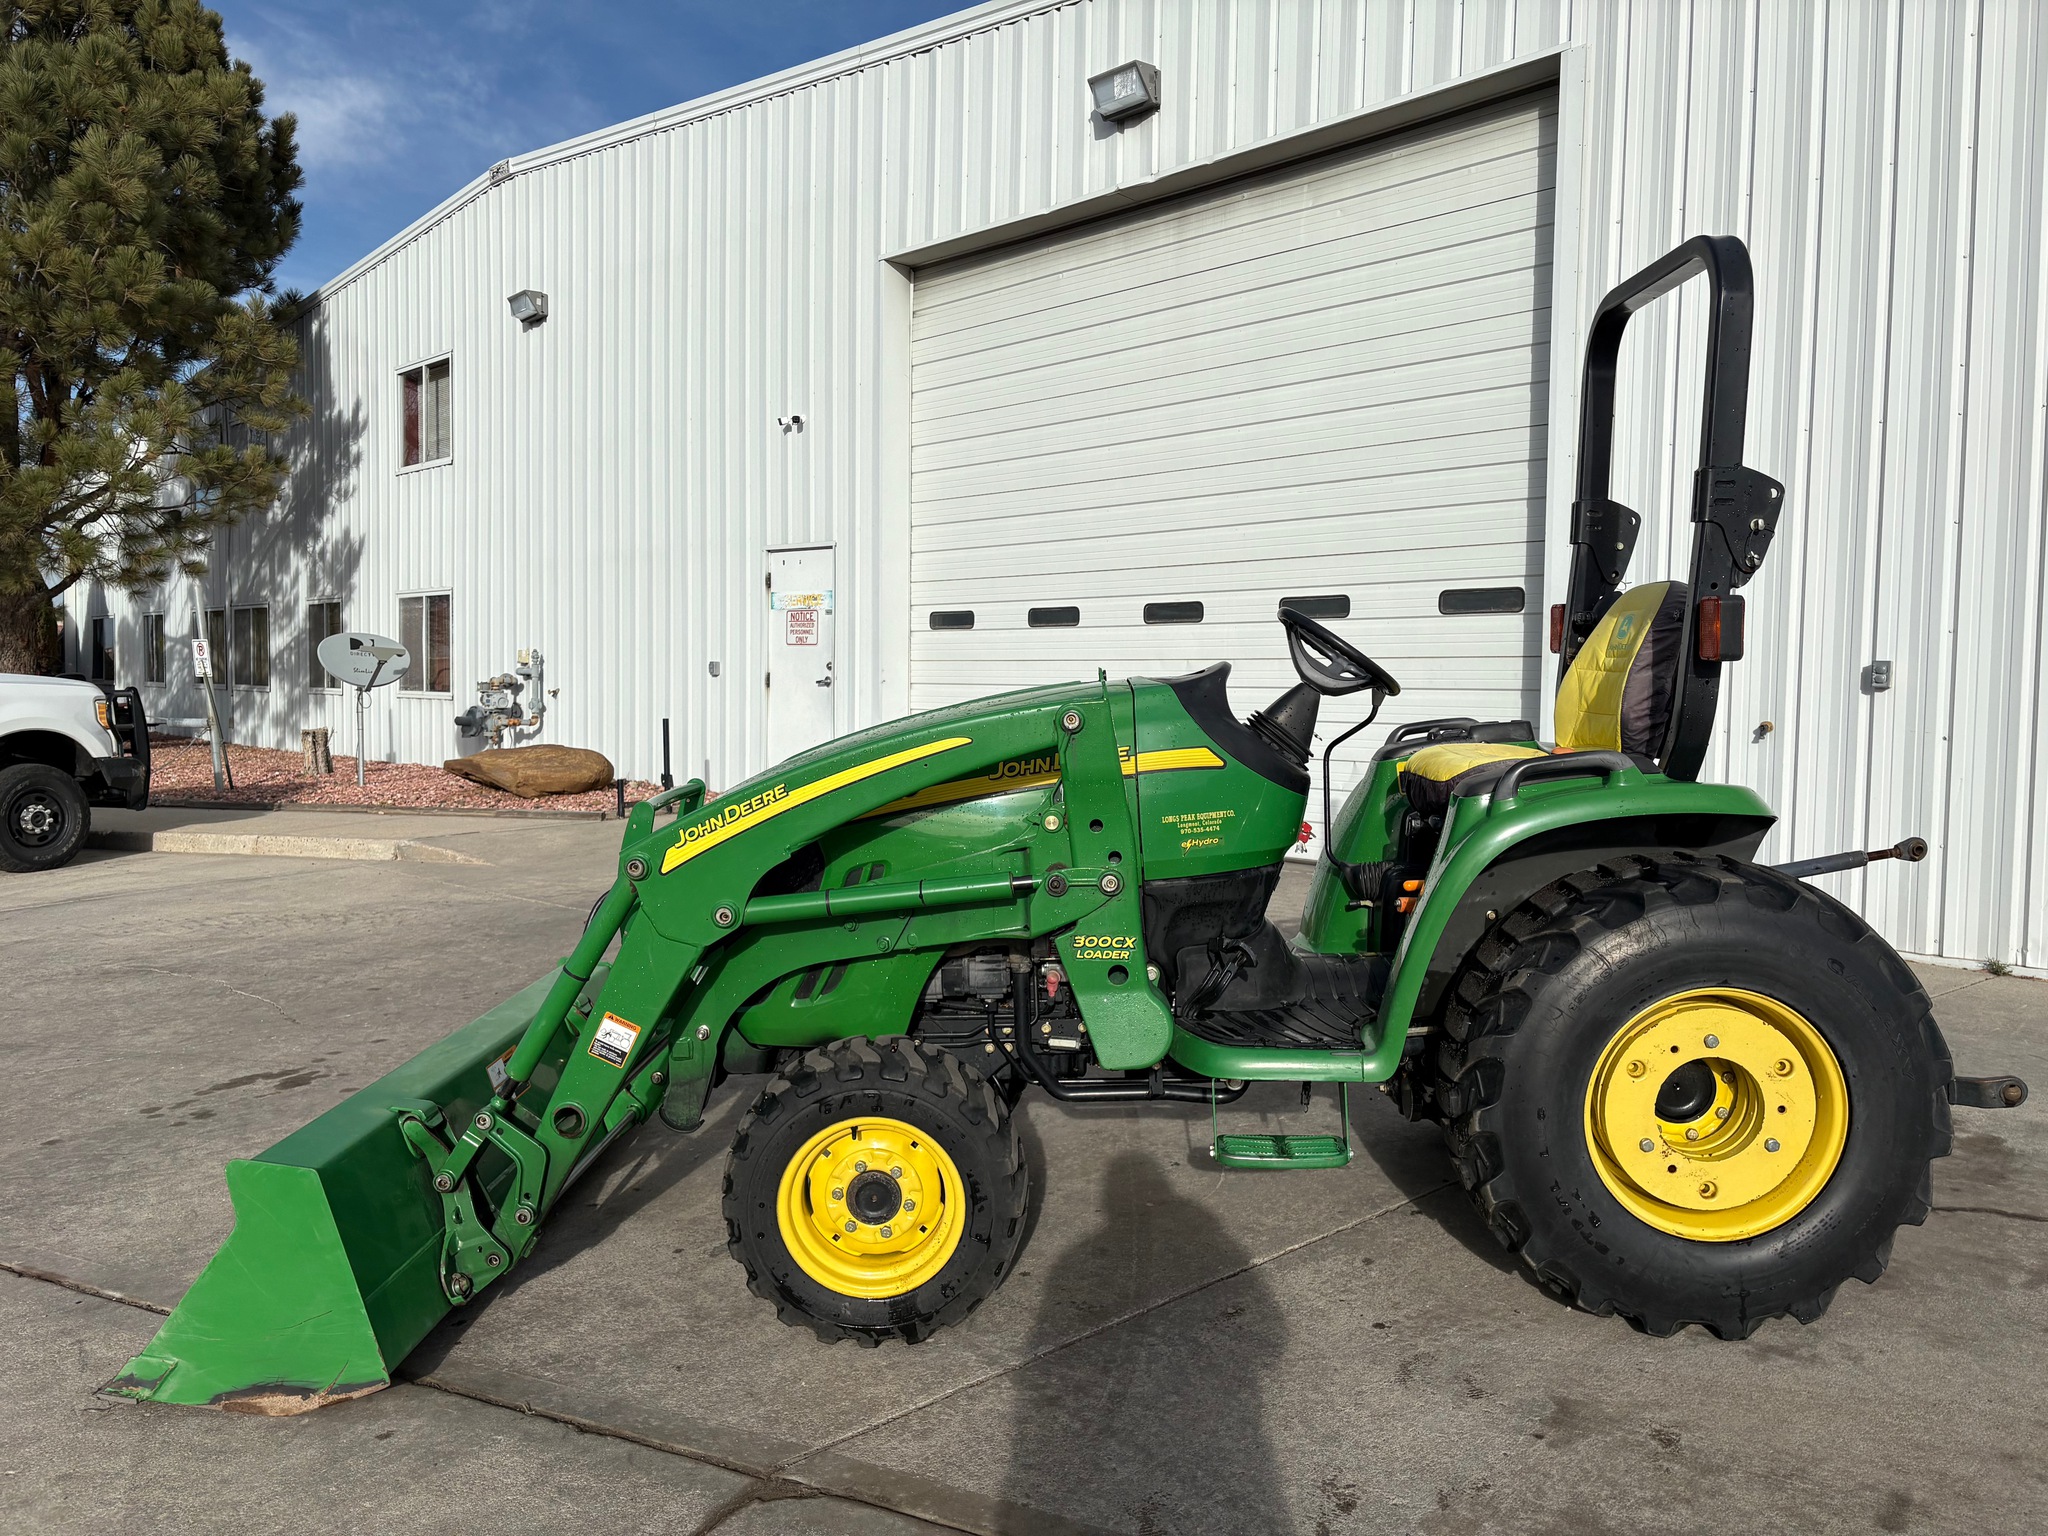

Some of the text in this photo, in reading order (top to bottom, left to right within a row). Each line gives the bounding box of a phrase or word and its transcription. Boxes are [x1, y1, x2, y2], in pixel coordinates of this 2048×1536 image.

[790, 612, 814, 621] NOTICE
[795, 636, 809, 644] ONLY
[988, 756, 1050, 780] JOHN
[674, 783, 789, 849] JOHN DEERE
[1161, 814, 1180, 824] LONGS
[1180, 813, 1196, 822] PEAK
[1197, 810, 1227, 820] EQUIPMENT
[1180, 826, 1220, 834] 970-535-4474
[1073, 935, 1137, 949] 300CX
[1076, 949, 1130, 960] LOADER
[614, 1016, 638, 1031] WARNING
